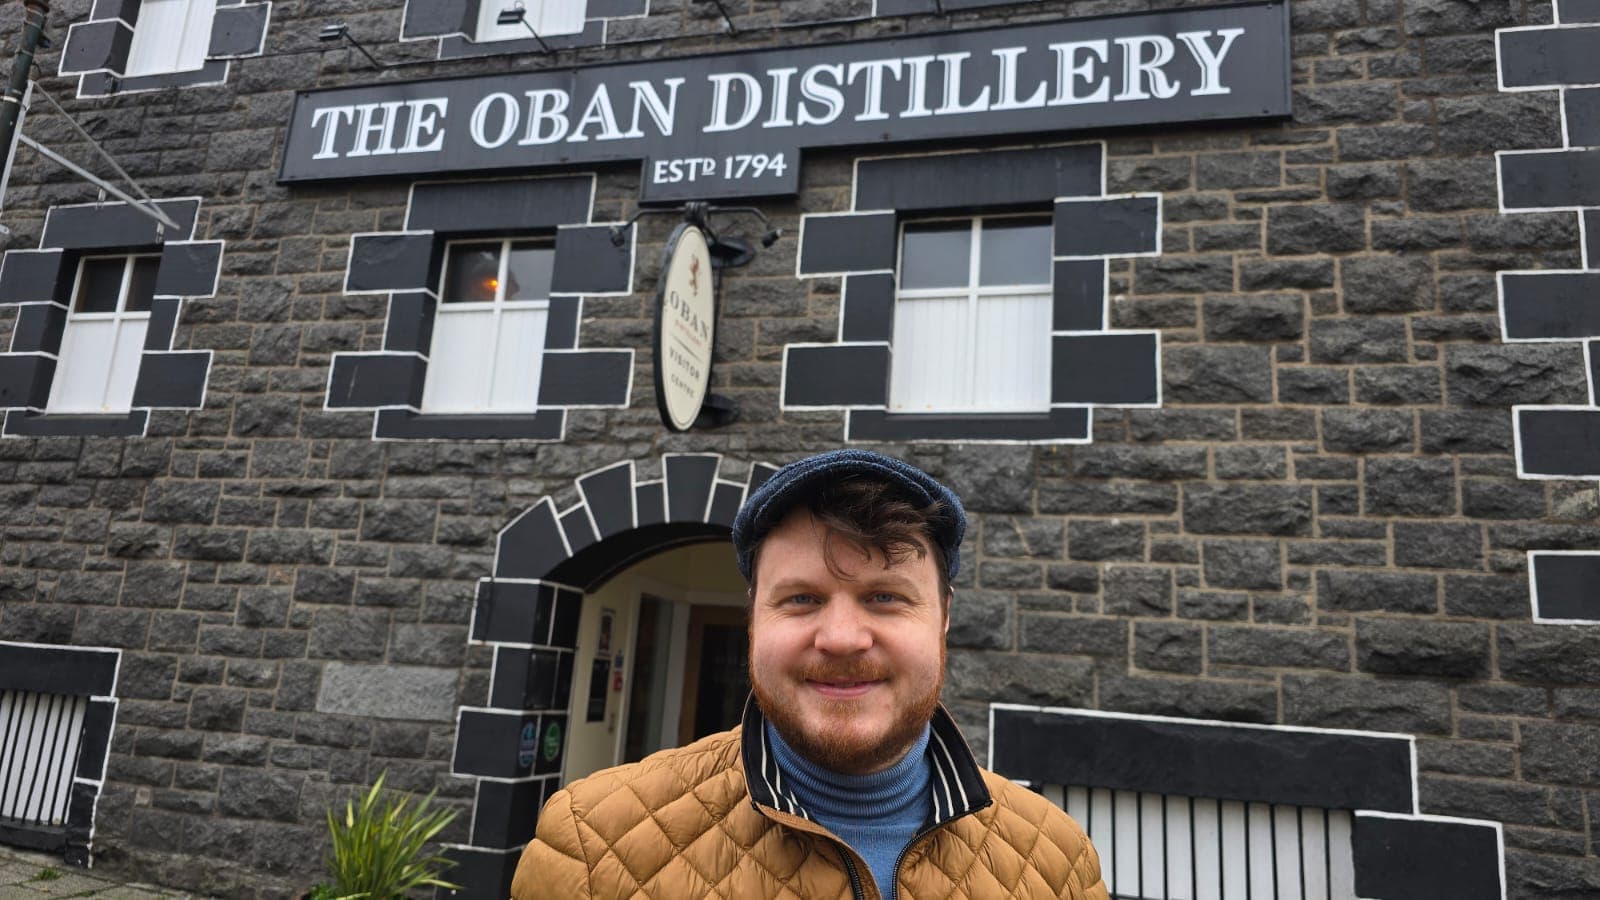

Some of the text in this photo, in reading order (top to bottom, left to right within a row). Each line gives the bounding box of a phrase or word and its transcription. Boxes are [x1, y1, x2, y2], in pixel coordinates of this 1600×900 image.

[310, 27, 1245, 160] THE OBAN DISTILLERY
[724, 152, 788, 180] 1794
[669, 290, 709, 341] OBAN
[669, 346, 700, 381] VISITOR
[670, 373, 695, 398] CENTRE
